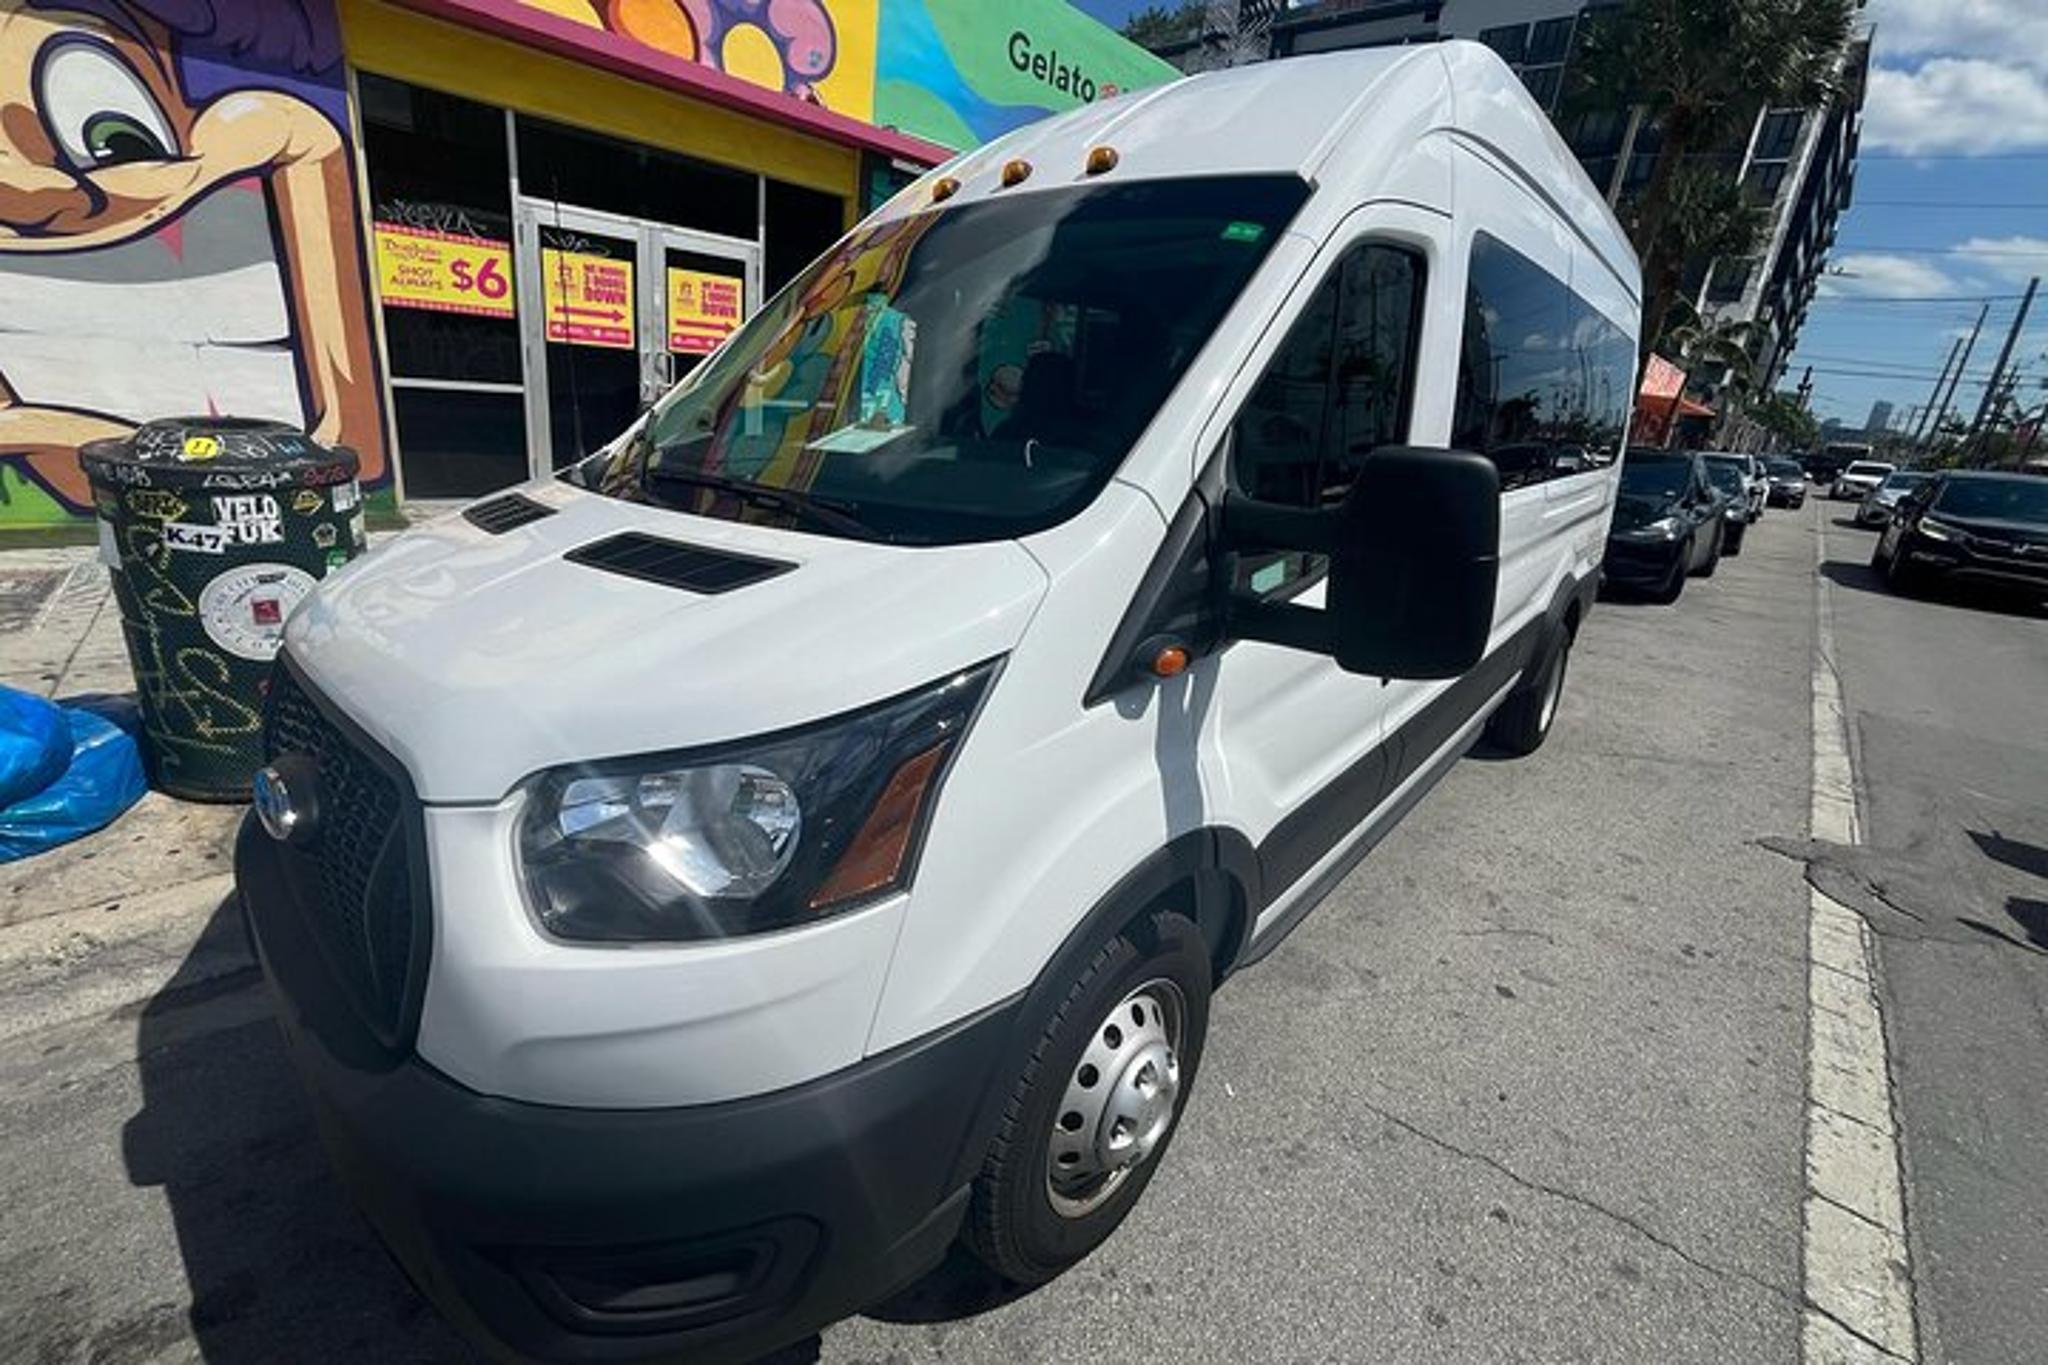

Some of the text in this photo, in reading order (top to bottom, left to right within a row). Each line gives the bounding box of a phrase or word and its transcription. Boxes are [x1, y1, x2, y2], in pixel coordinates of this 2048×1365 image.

[1008, 31, 1095, 103] Gelato
[450, 257, 508, 300] $6
[584, 288, 627, 305] DOWN
[212, 495, 278, 521] VELO
